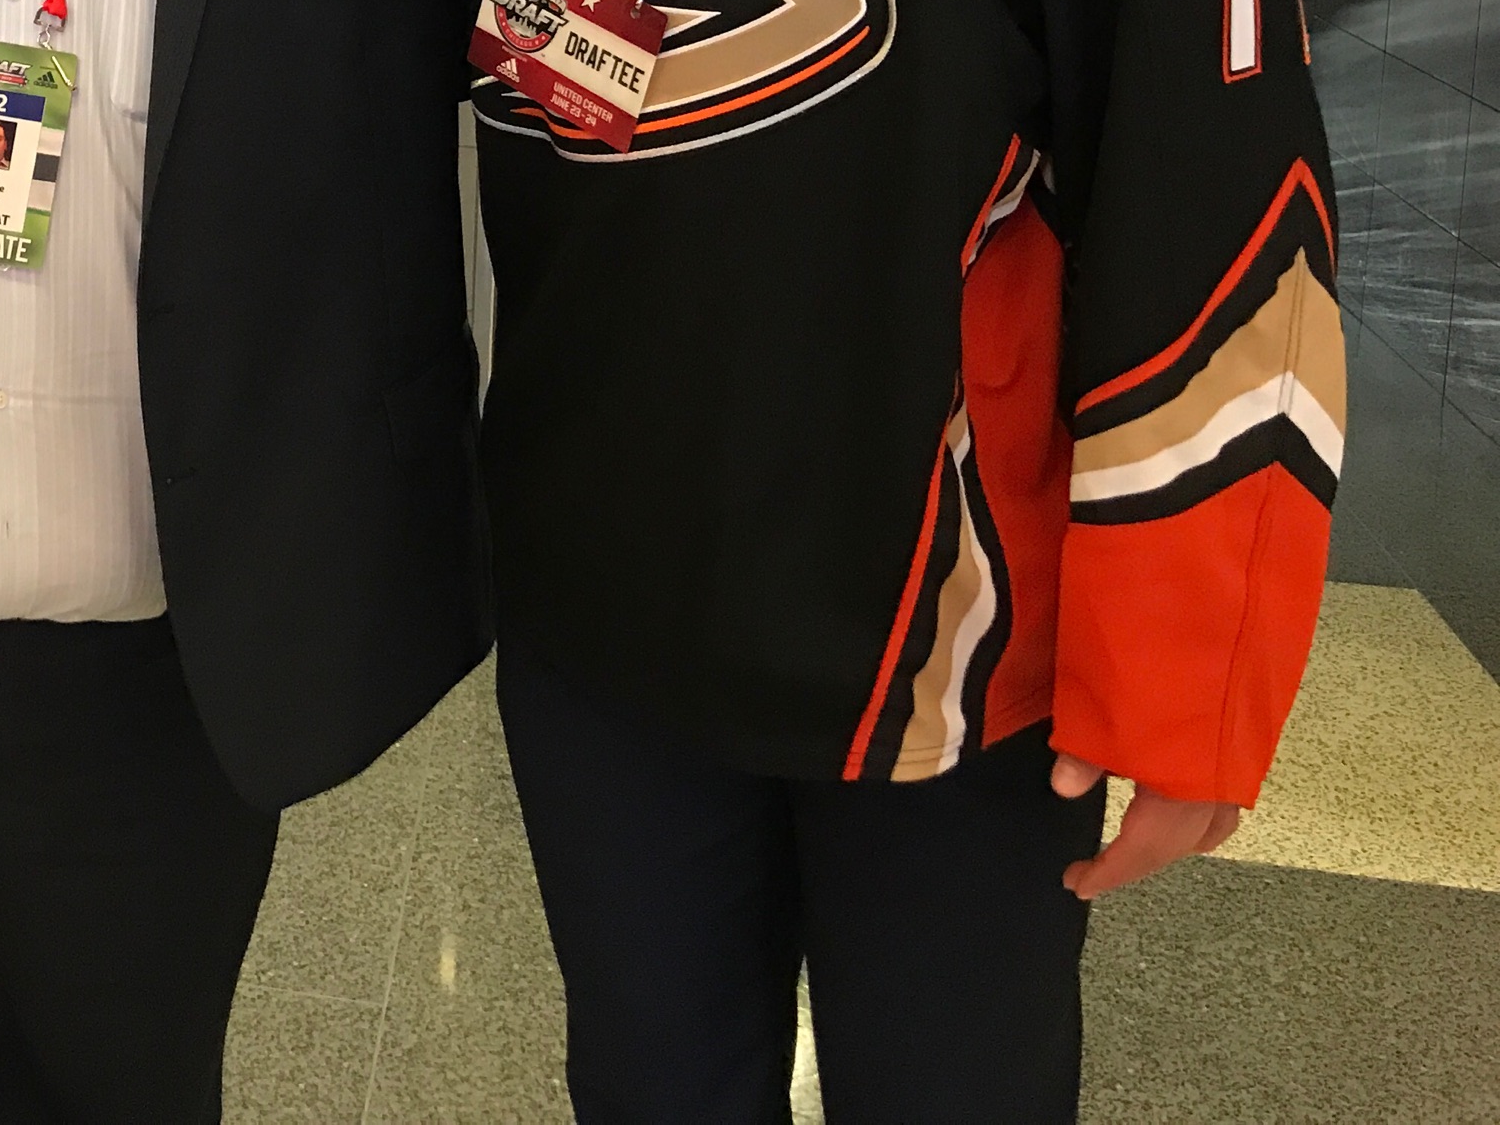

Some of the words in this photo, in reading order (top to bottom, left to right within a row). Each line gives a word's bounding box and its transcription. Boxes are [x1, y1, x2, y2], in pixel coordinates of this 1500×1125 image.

[496, 65, 520, 83] adidas
[564, 31, 645, 94] DRAFTEE
[550, 93, 570, 112] JUNE
[570, 104, 582, 118] 23
[585, 113, 597, 127] 24
[553, 81, 583, 105] UNITED
[582, 98, 613, 123] CENTER
